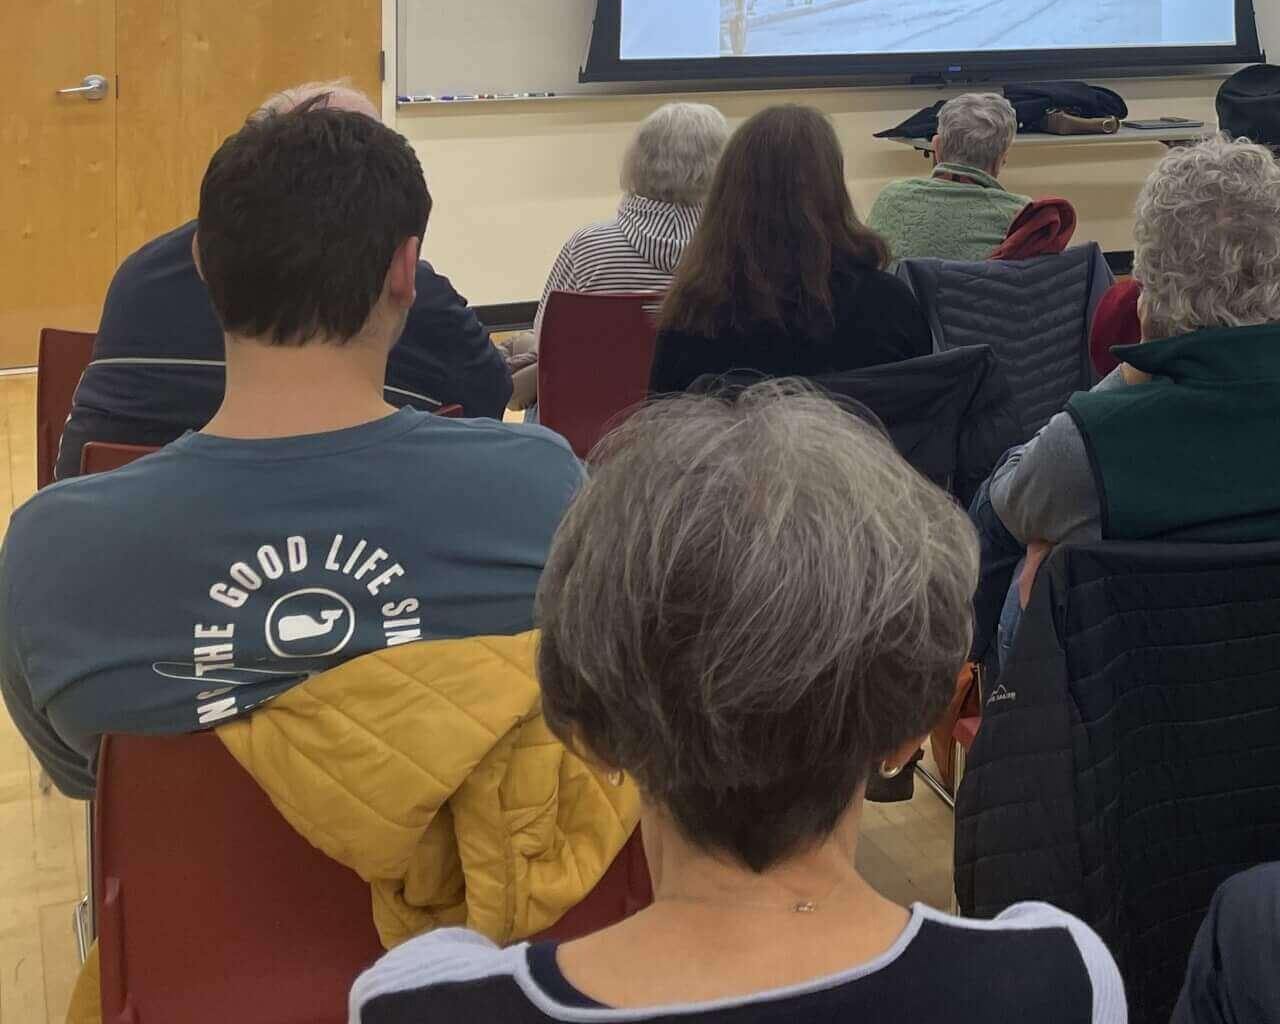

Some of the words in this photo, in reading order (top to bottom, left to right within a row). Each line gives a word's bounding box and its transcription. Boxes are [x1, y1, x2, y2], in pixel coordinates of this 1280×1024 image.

[208, 535, 309, 609] GOOD
[324, 533, 406, 597] LIFE
[193, 622, 235, 677] THE
